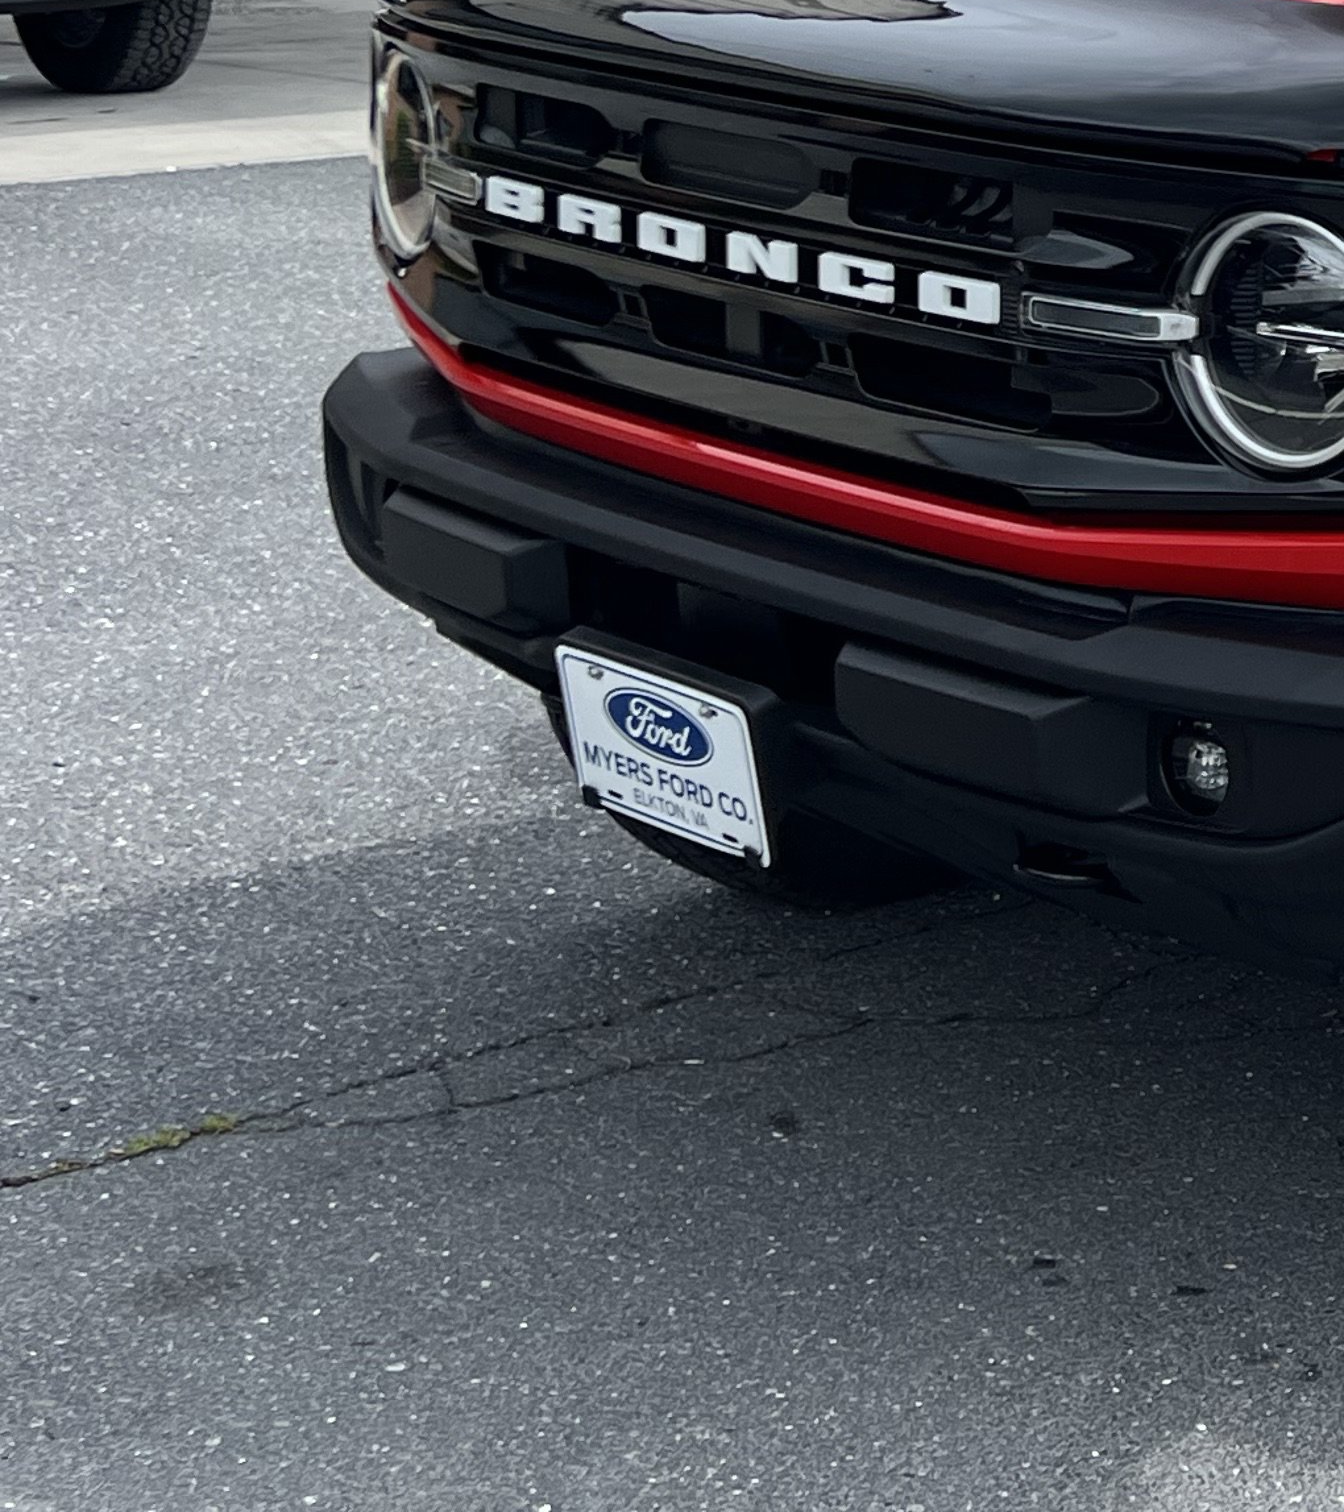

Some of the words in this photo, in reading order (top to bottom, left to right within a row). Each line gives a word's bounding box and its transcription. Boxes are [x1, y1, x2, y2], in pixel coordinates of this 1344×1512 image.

[485, 175, 1001, 325] BRONCO
[625, 696, 693, 757] Ford
[583, 741, 654, 787] MYERS
[657, 769, 714, 809] FORD
[718, 791, 754, 825] CO.
